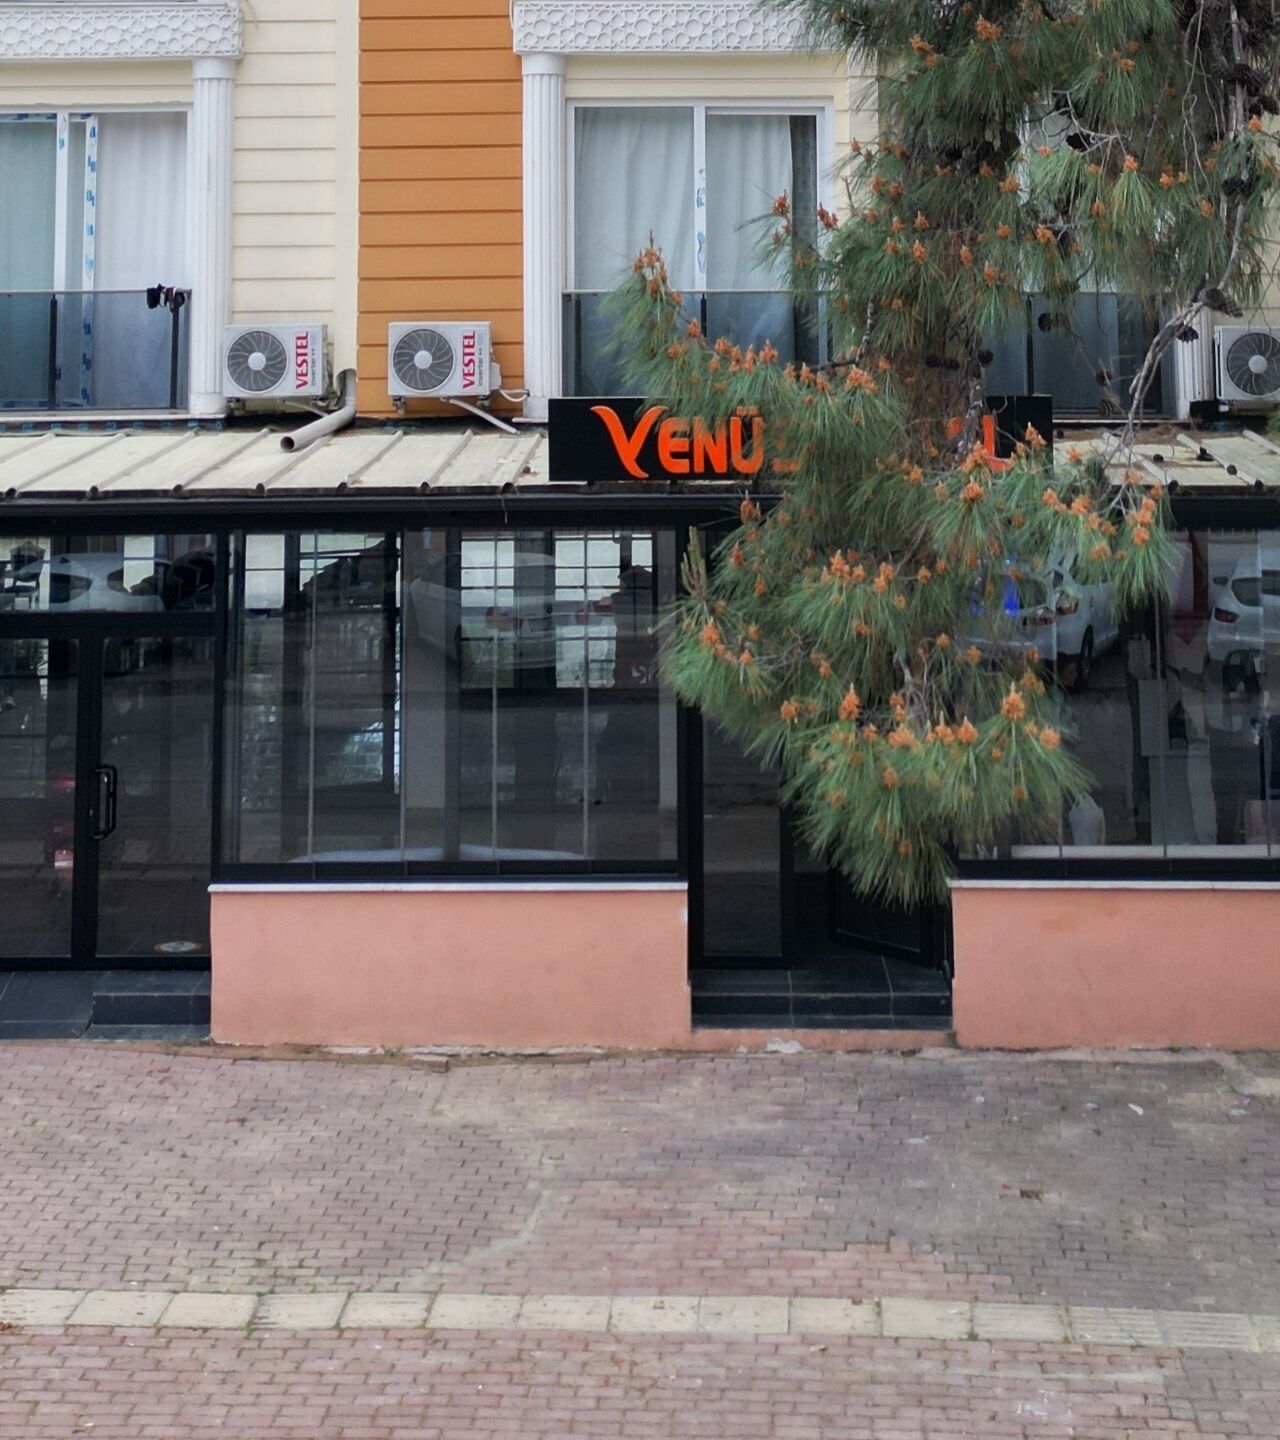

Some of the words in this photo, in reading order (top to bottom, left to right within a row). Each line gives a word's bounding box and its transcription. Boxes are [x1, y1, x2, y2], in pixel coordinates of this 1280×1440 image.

[295, 331, 309, 389] VESTEL
[463, 330, 476, 389] VESTEL
[591, 406, 800, 479] VENÜ
